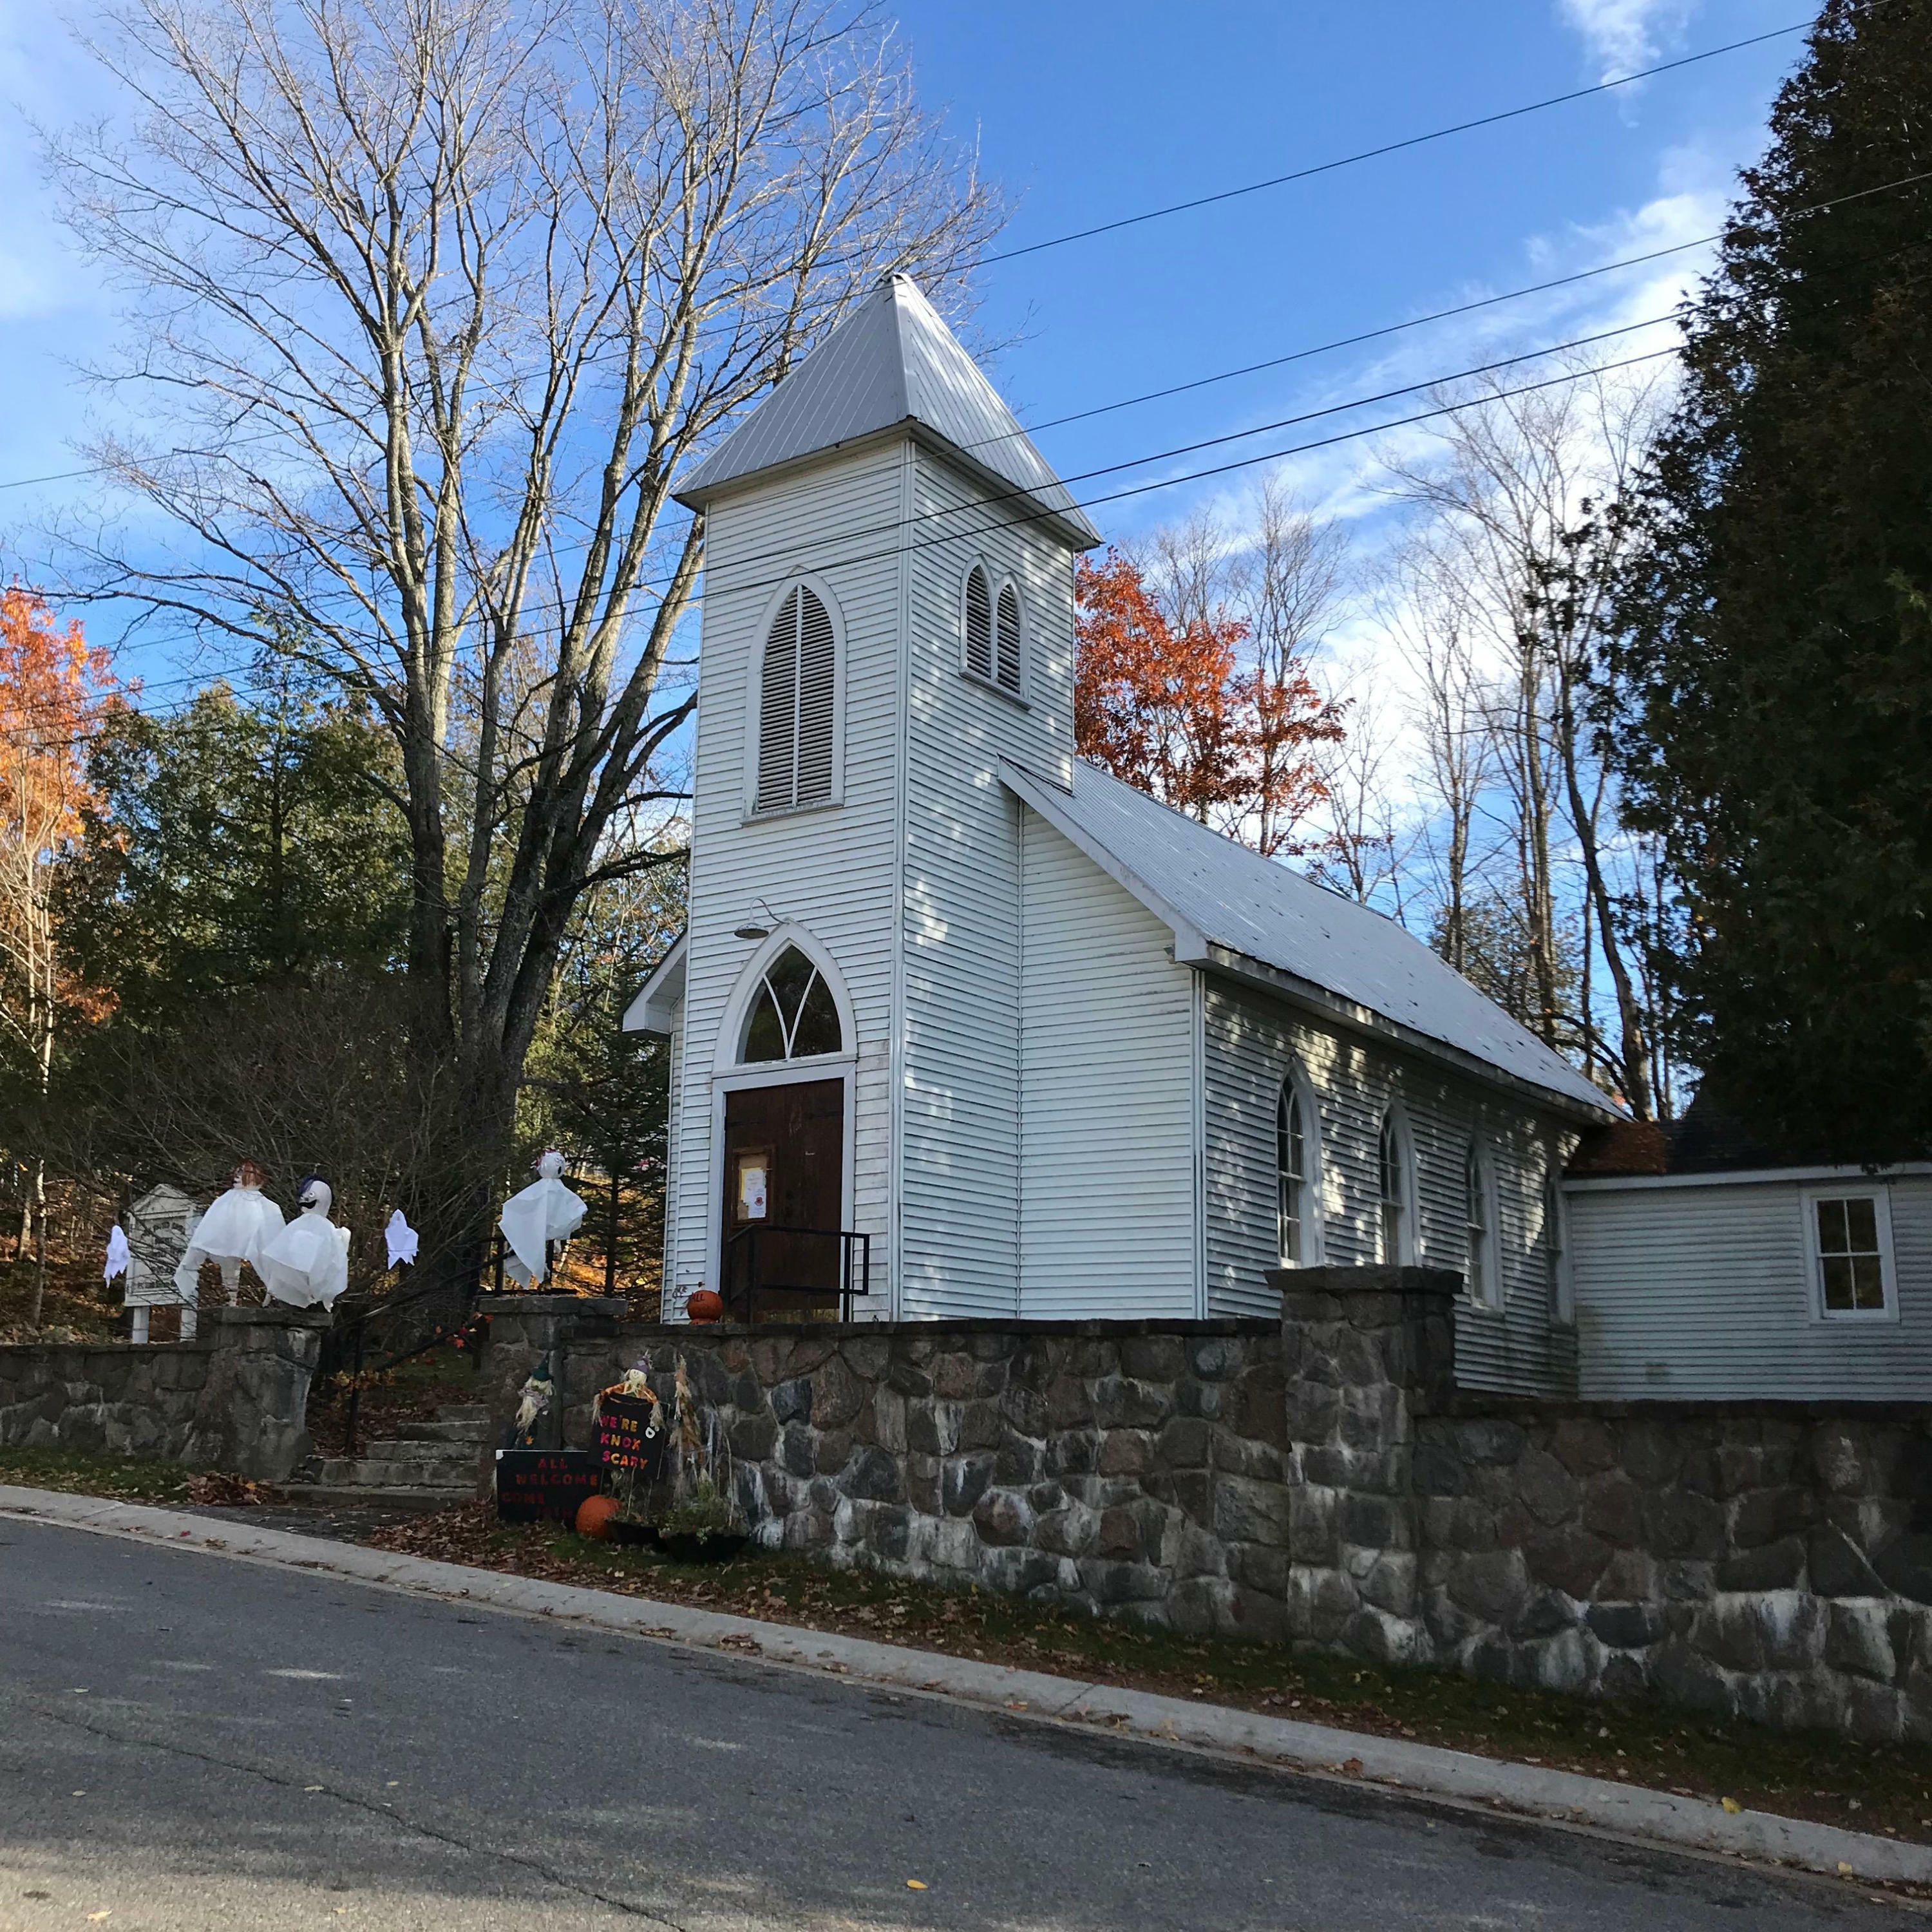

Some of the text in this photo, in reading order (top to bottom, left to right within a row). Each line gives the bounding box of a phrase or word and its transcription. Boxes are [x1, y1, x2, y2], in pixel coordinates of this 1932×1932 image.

[600, 1414, 638, 1432] WE'RE
[600, 1433, 641, 1450] KNOX
[538, 1457, 567, 1469] ALL
[602, 1450, 649, 1470] SCARY
[515, 1473, 598, 1487] WELCOME
[500, 1491, 545, 1504] COME
